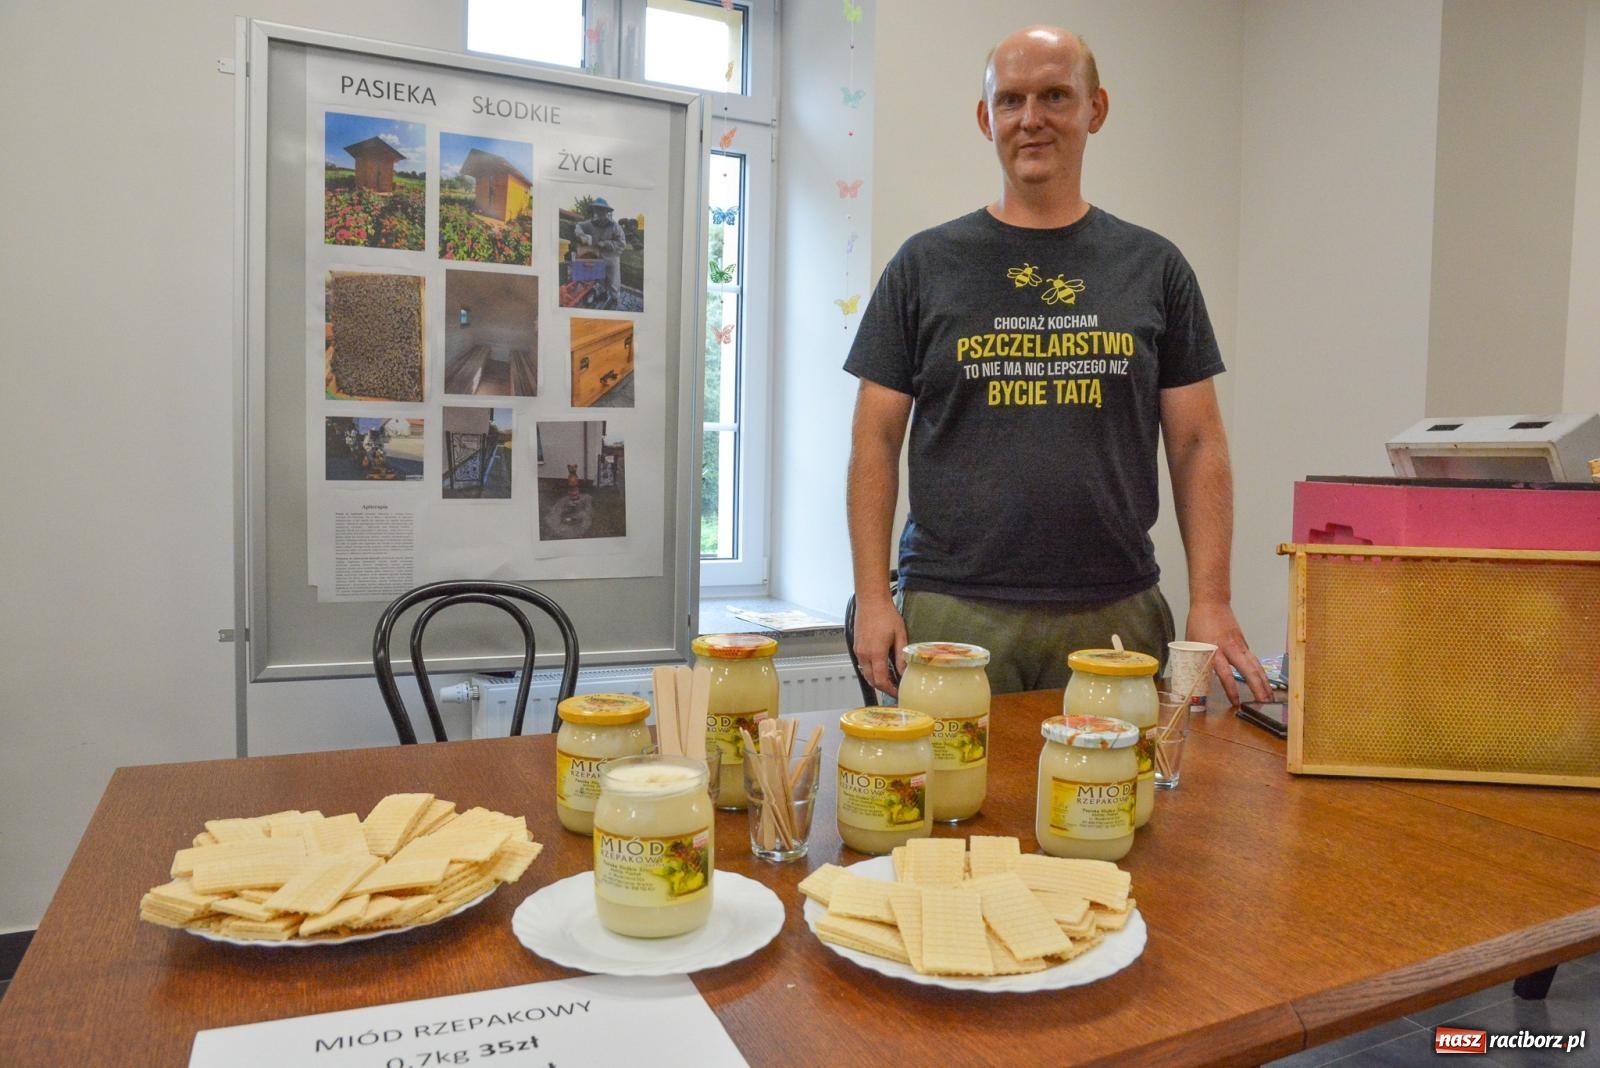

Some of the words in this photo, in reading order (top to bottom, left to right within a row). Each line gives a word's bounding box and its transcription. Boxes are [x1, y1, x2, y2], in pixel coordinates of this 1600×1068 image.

[341, 75, 437, 106] PASIEKA
[471, 95, 562, 125] SŁODKIE
[557, 149, 613, 176] ŻYCIE
[994, 315, 1045, 330] CHOCIAŻ
[1048, 314, 1098, 330] KOCHAM
[957, 331, 1134, 361] PSZCZELARSTWO
[964, 364, 979, 379] TO
[982, 361, 1001, 377] NIE
[1003, 361, 1022, 376] MA
[1025, 362, 1045, 376] NIC
[1047, 359, 1106, 376] LEPSZEGO
[1109, 357, 1129, 375] NIŻ
[988, 380, 1047, 406] BYCIE
[1053, 379, 1104, 408] TATĄ
[840, 768, 886, 790] MIÓD
[1077, 781, 1131, 798] MIÓD
[600, 835, 665, 857] MIÓD
[315, 1028, 404, 1052] MIÓD
[414, 1000, 592, 1038] RZEPAKOWY
[479, 1035, 540, 1057] 35zł
